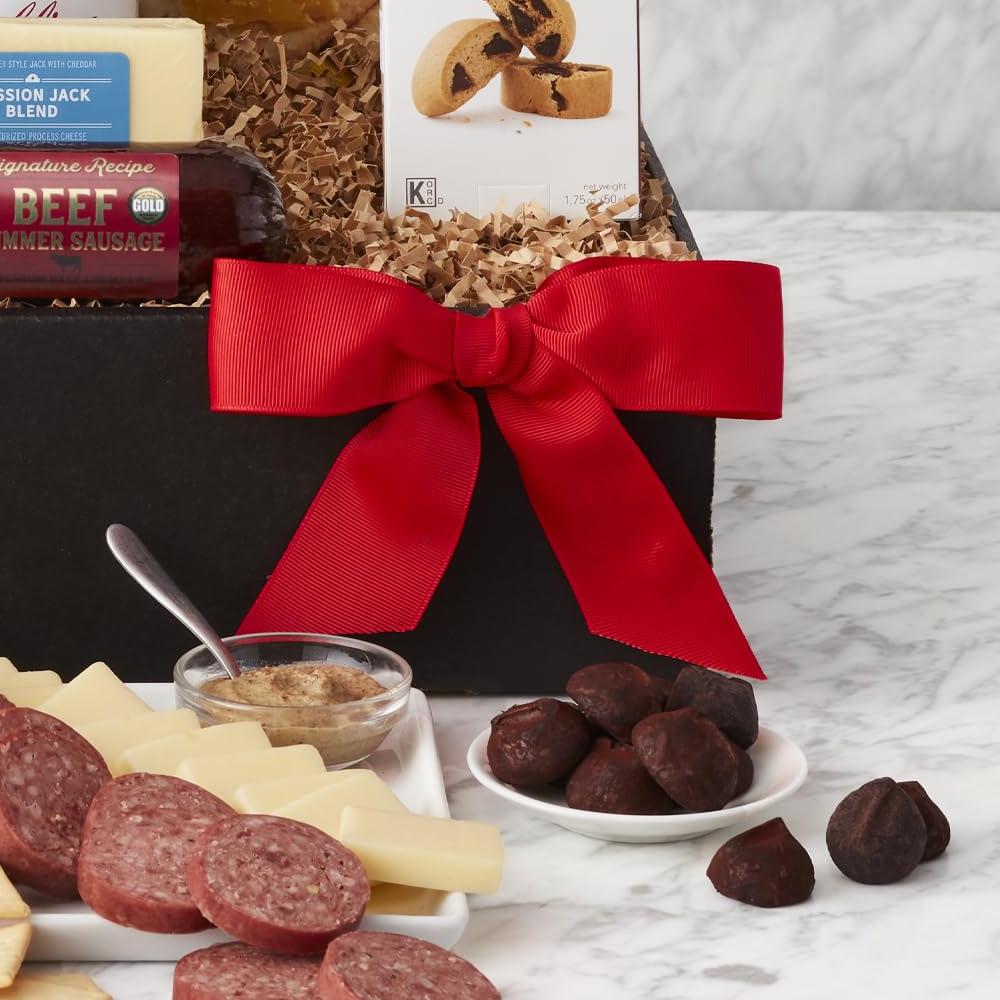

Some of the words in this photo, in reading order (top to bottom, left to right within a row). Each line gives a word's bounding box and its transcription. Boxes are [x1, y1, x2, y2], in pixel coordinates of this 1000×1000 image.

[8, 60, 28, 69] STYLE
[29, 60, 46, 69] JACK
[48, 60, 65, 69] WITH
[66, 60, 97, 69] CHEDDAR
[49, 88, 91, 102] JACK
[6, 104, 58, 118] BLEND
[28, 132, 59, 141] PROCESS
[60, 132, 87, 141] CHEESE
[84, 157, 157, 177] Recipe
[13, 186, 118, 226] BEEF
[132, 198, 164, 212] GOLD
[69, 231, 165, 252] SAUSAGE
